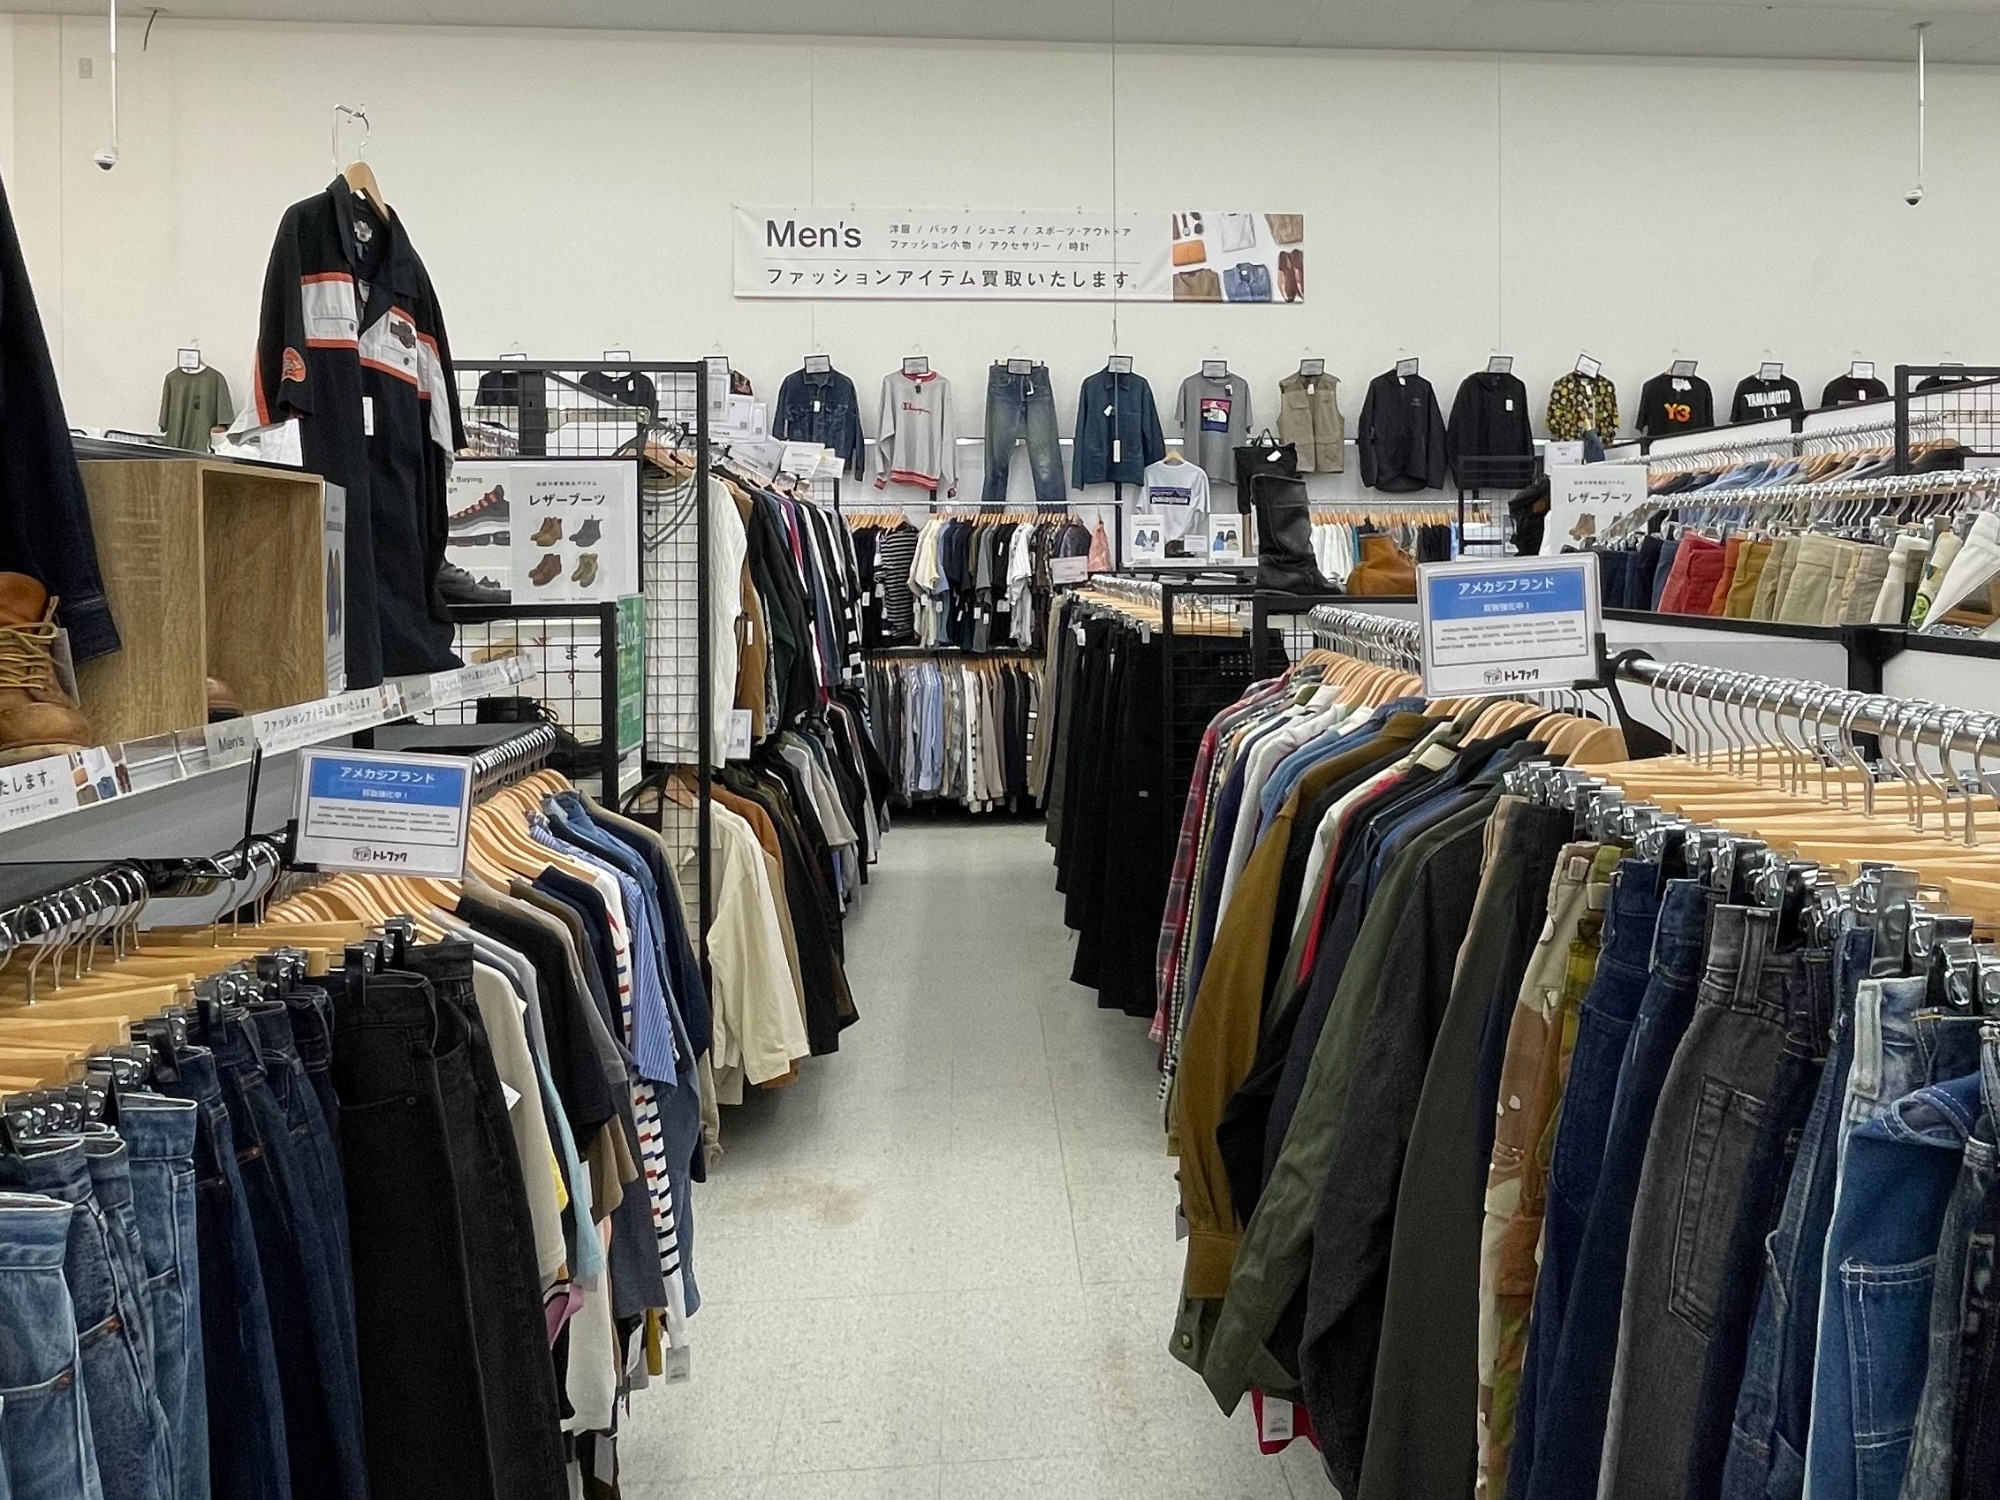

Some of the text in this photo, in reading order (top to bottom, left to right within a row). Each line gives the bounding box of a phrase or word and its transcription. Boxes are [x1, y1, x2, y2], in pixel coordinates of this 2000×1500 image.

[766, 220, 862, 248] Men's
[929, 224, 958, 234] バッグ
[978, 225, 1017, 235] シューズ
[890, 240, 972, 250] ファッション小物
[990, 241, 1051, 251] アクセサリー
[1068, 241, 1089, 251] 時計
[1744, 389, 1791, 407] YAMAMOTO
[529, 492, 606, 506] レザーブーツ
[1568, 491, 1632, 503] レザーブーツ
[1458, 577, 1555, 595] アメカジブランド
[1504, 668, 1540, 682] トレファク
[218, 736, 246, 751] Men's
[340, 766, 436, 784] アメカジブランド
[372, 850, 408, 862] トレファク
